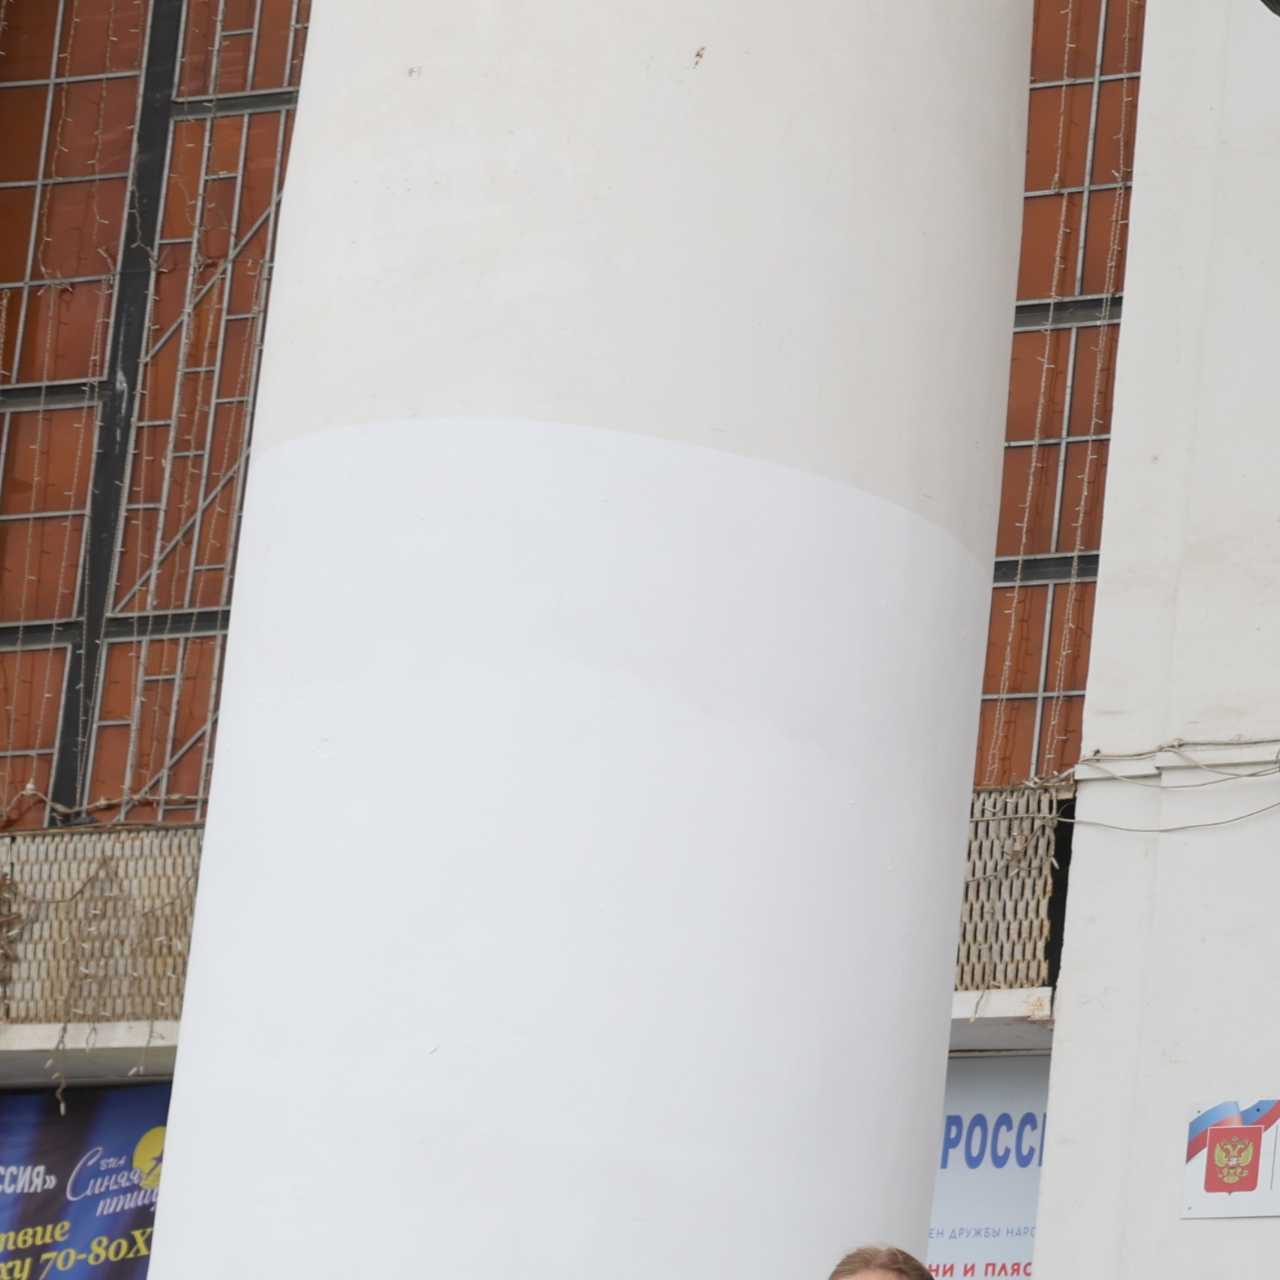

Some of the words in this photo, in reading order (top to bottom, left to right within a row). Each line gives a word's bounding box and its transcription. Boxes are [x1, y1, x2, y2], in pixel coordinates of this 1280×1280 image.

[940, 1112, 1047, 1169] РОСС
[96, 1187, 159, 1217] птиц
[949, 1226, 1001, 1240] ДРУЖБЫ
[963, 1264, 975, 1278] И
[984, 1262, 1033, 1278] ПЛЯС
